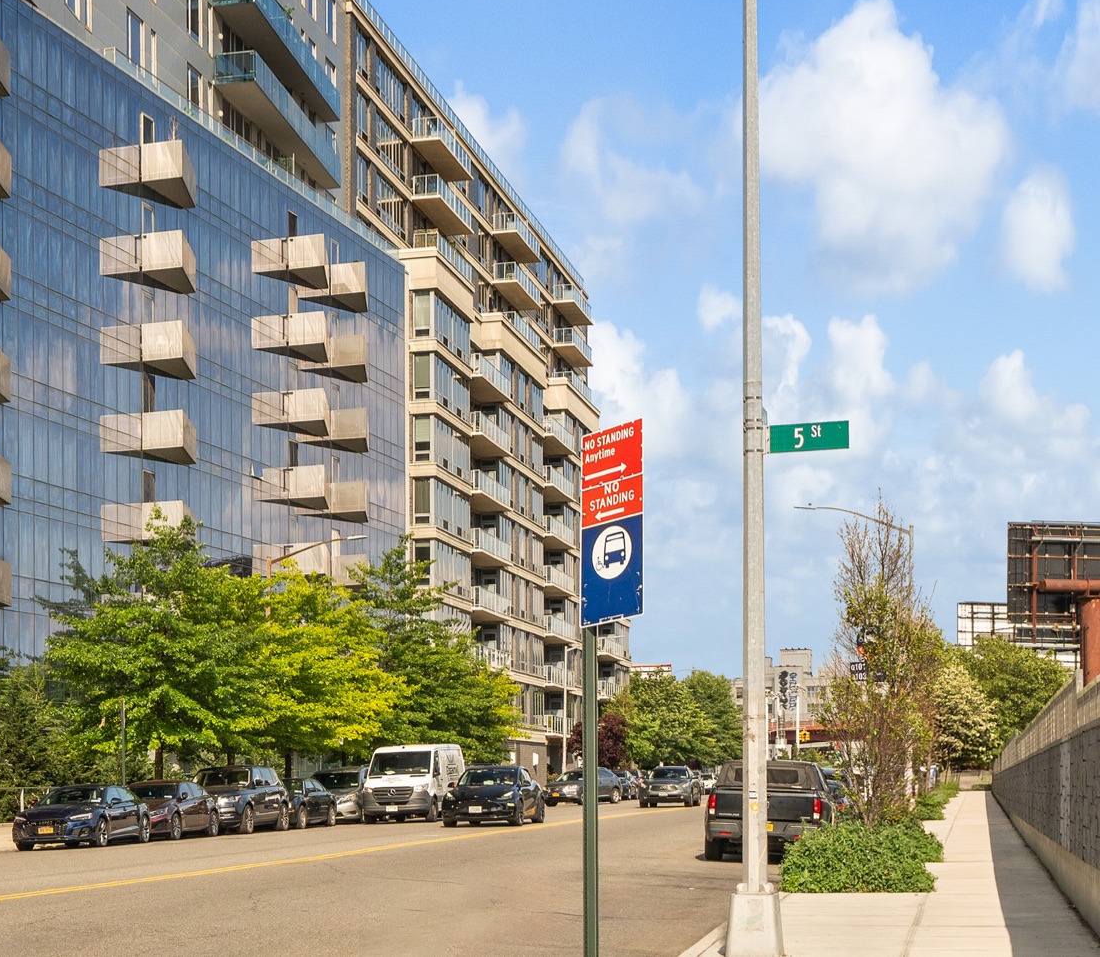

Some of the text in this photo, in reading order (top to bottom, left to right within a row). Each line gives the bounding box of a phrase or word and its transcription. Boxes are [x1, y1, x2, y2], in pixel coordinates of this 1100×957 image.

[584, 426, 635, 451] NO STANDING
[793, 424, 822, 449] 5 St
[584, 447, 616, 464] Anytime
[604, 481, 620, 495] NO
[589, 489, 635, 512] STANDING
